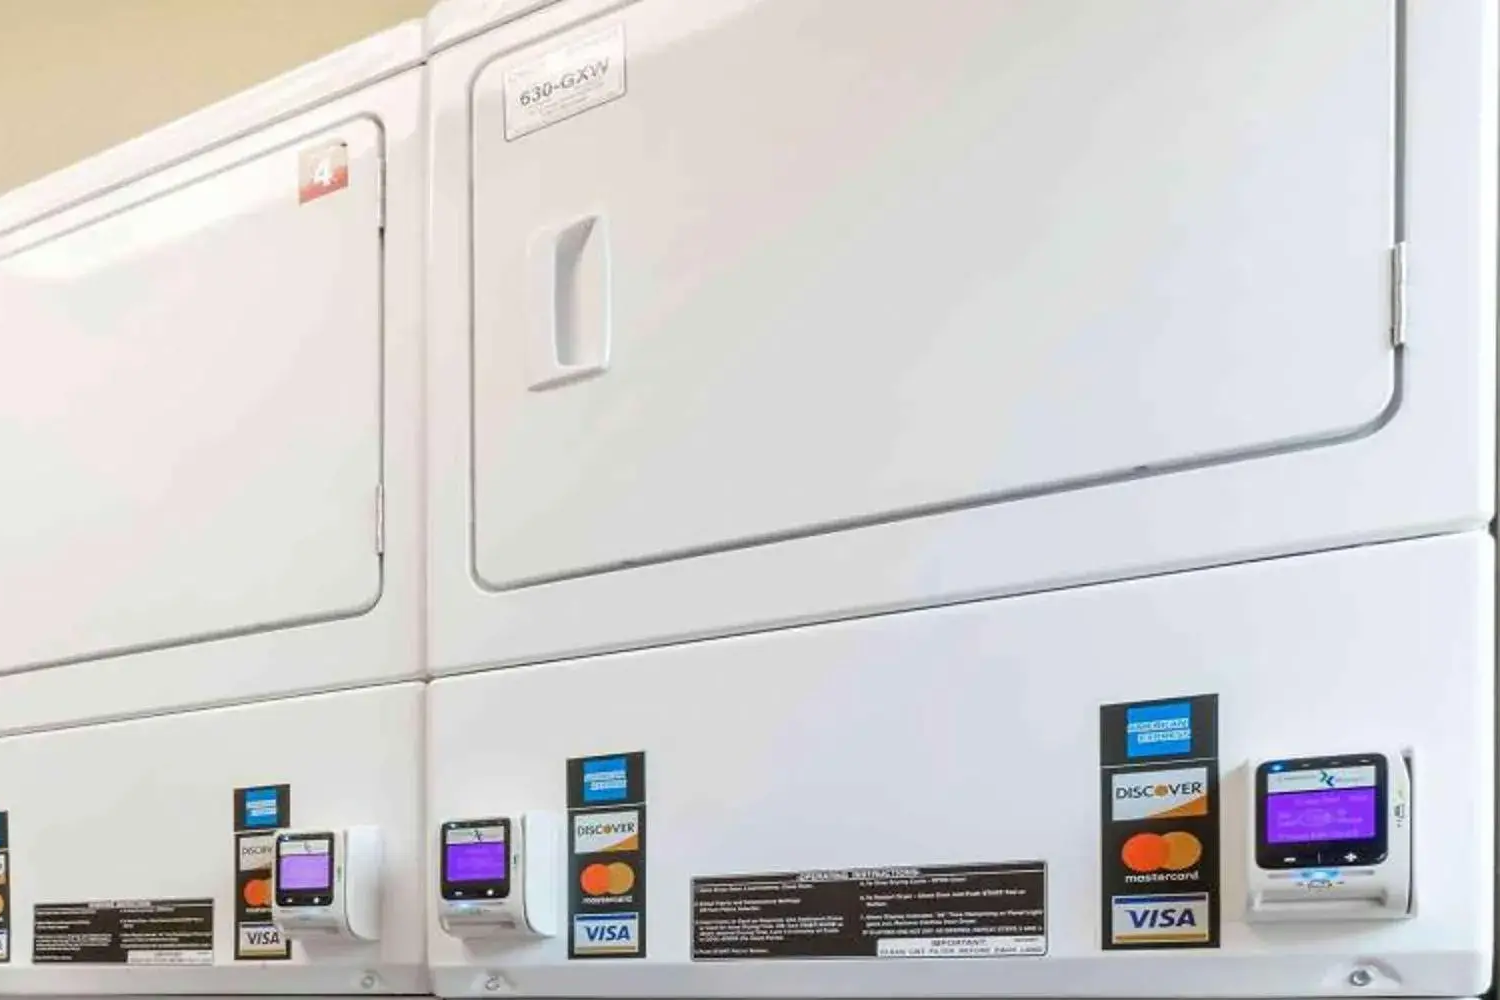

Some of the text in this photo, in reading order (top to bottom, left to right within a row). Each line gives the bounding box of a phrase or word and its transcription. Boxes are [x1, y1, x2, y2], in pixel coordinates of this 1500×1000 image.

[520, 56, 610, 106] 630-GXW
[313, 160, 332, 187] 4
[1115, 782, 1202, 799] DISCOVER
[577, 823, 635, 836] DISCOVER
[1124, 871, 1200, 884] mastercard
[1125, 908, 1197, 929] VISA
[247, 931, 281, 945] VISA
[585, 925, 631, 942] VISA
